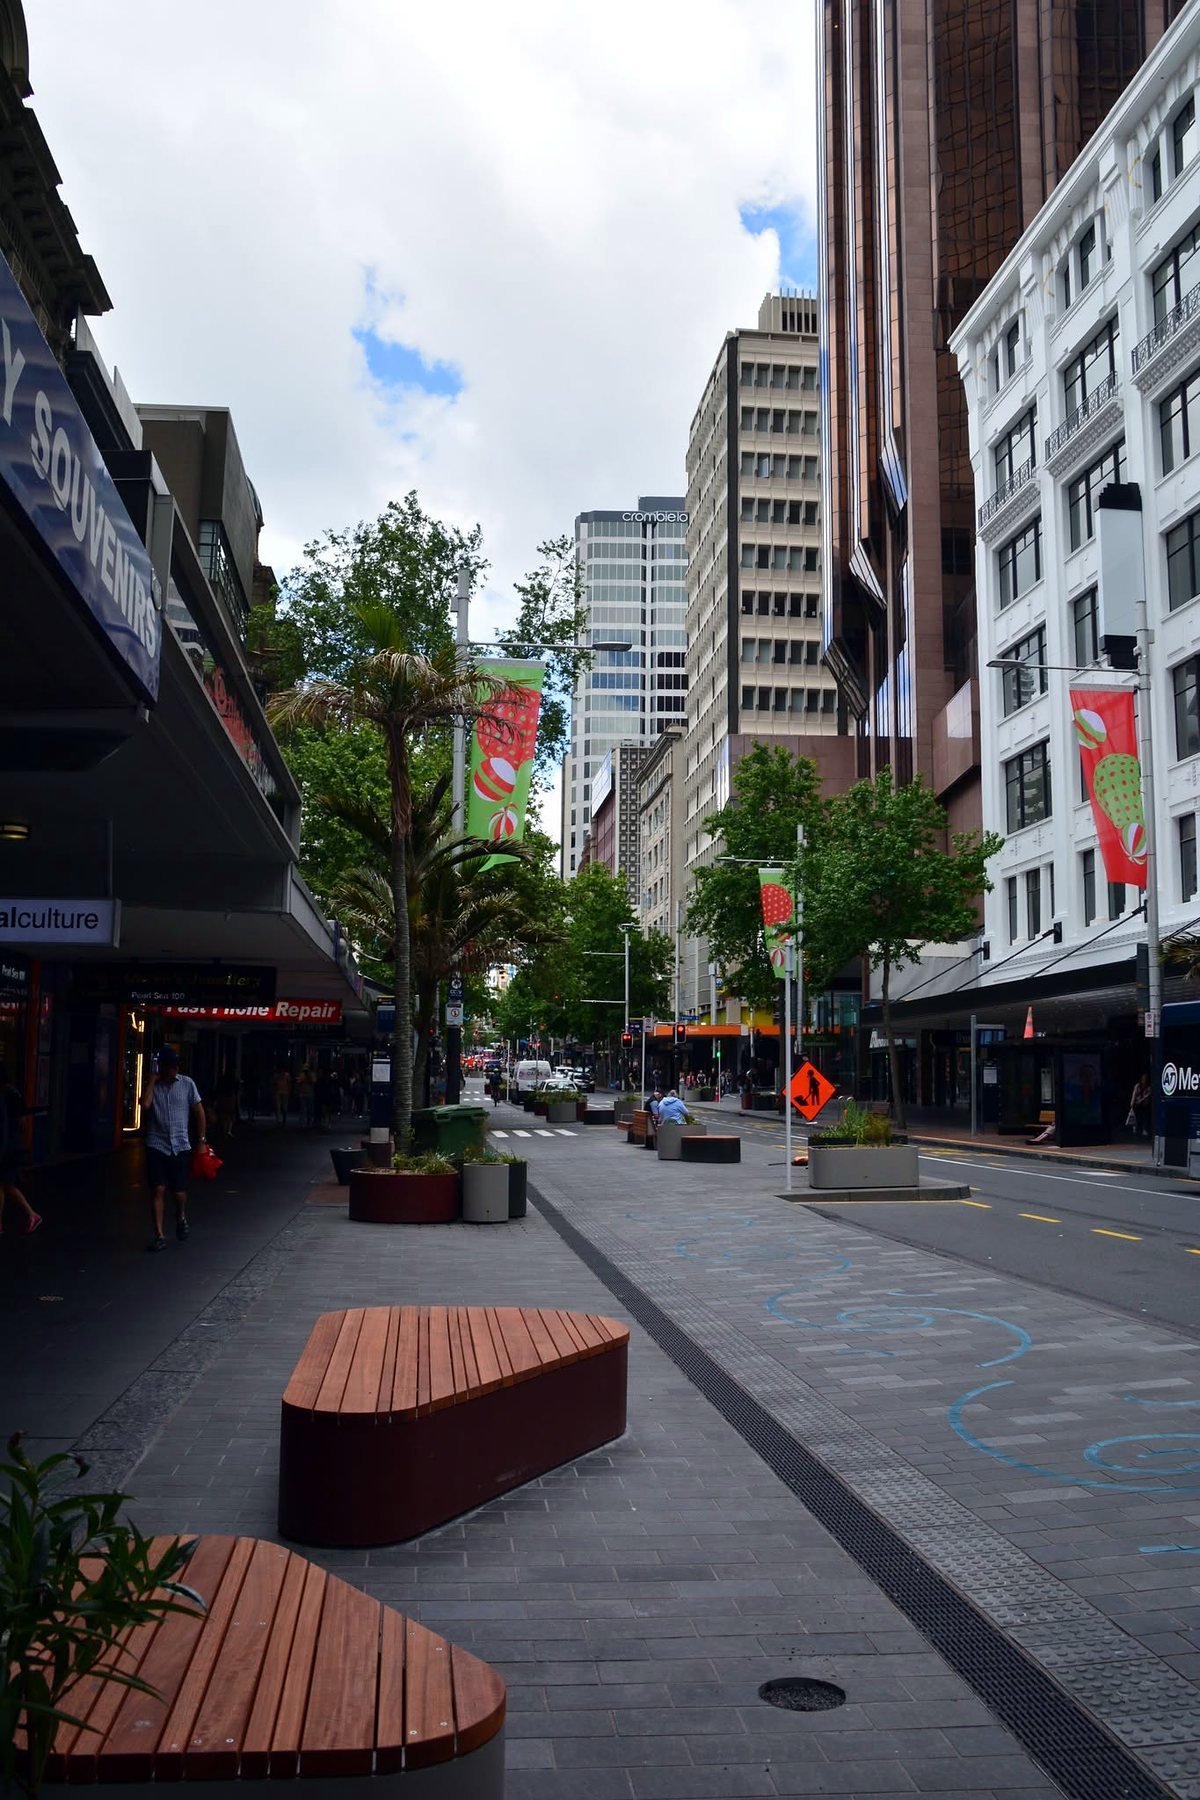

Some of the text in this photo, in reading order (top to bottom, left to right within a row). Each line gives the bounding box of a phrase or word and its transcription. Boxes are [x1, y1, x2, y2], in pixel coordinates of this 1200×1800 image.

[1, 317, 157, 659] Y SOUVENIRS
[275, 1001, 337, 1020] Repair
